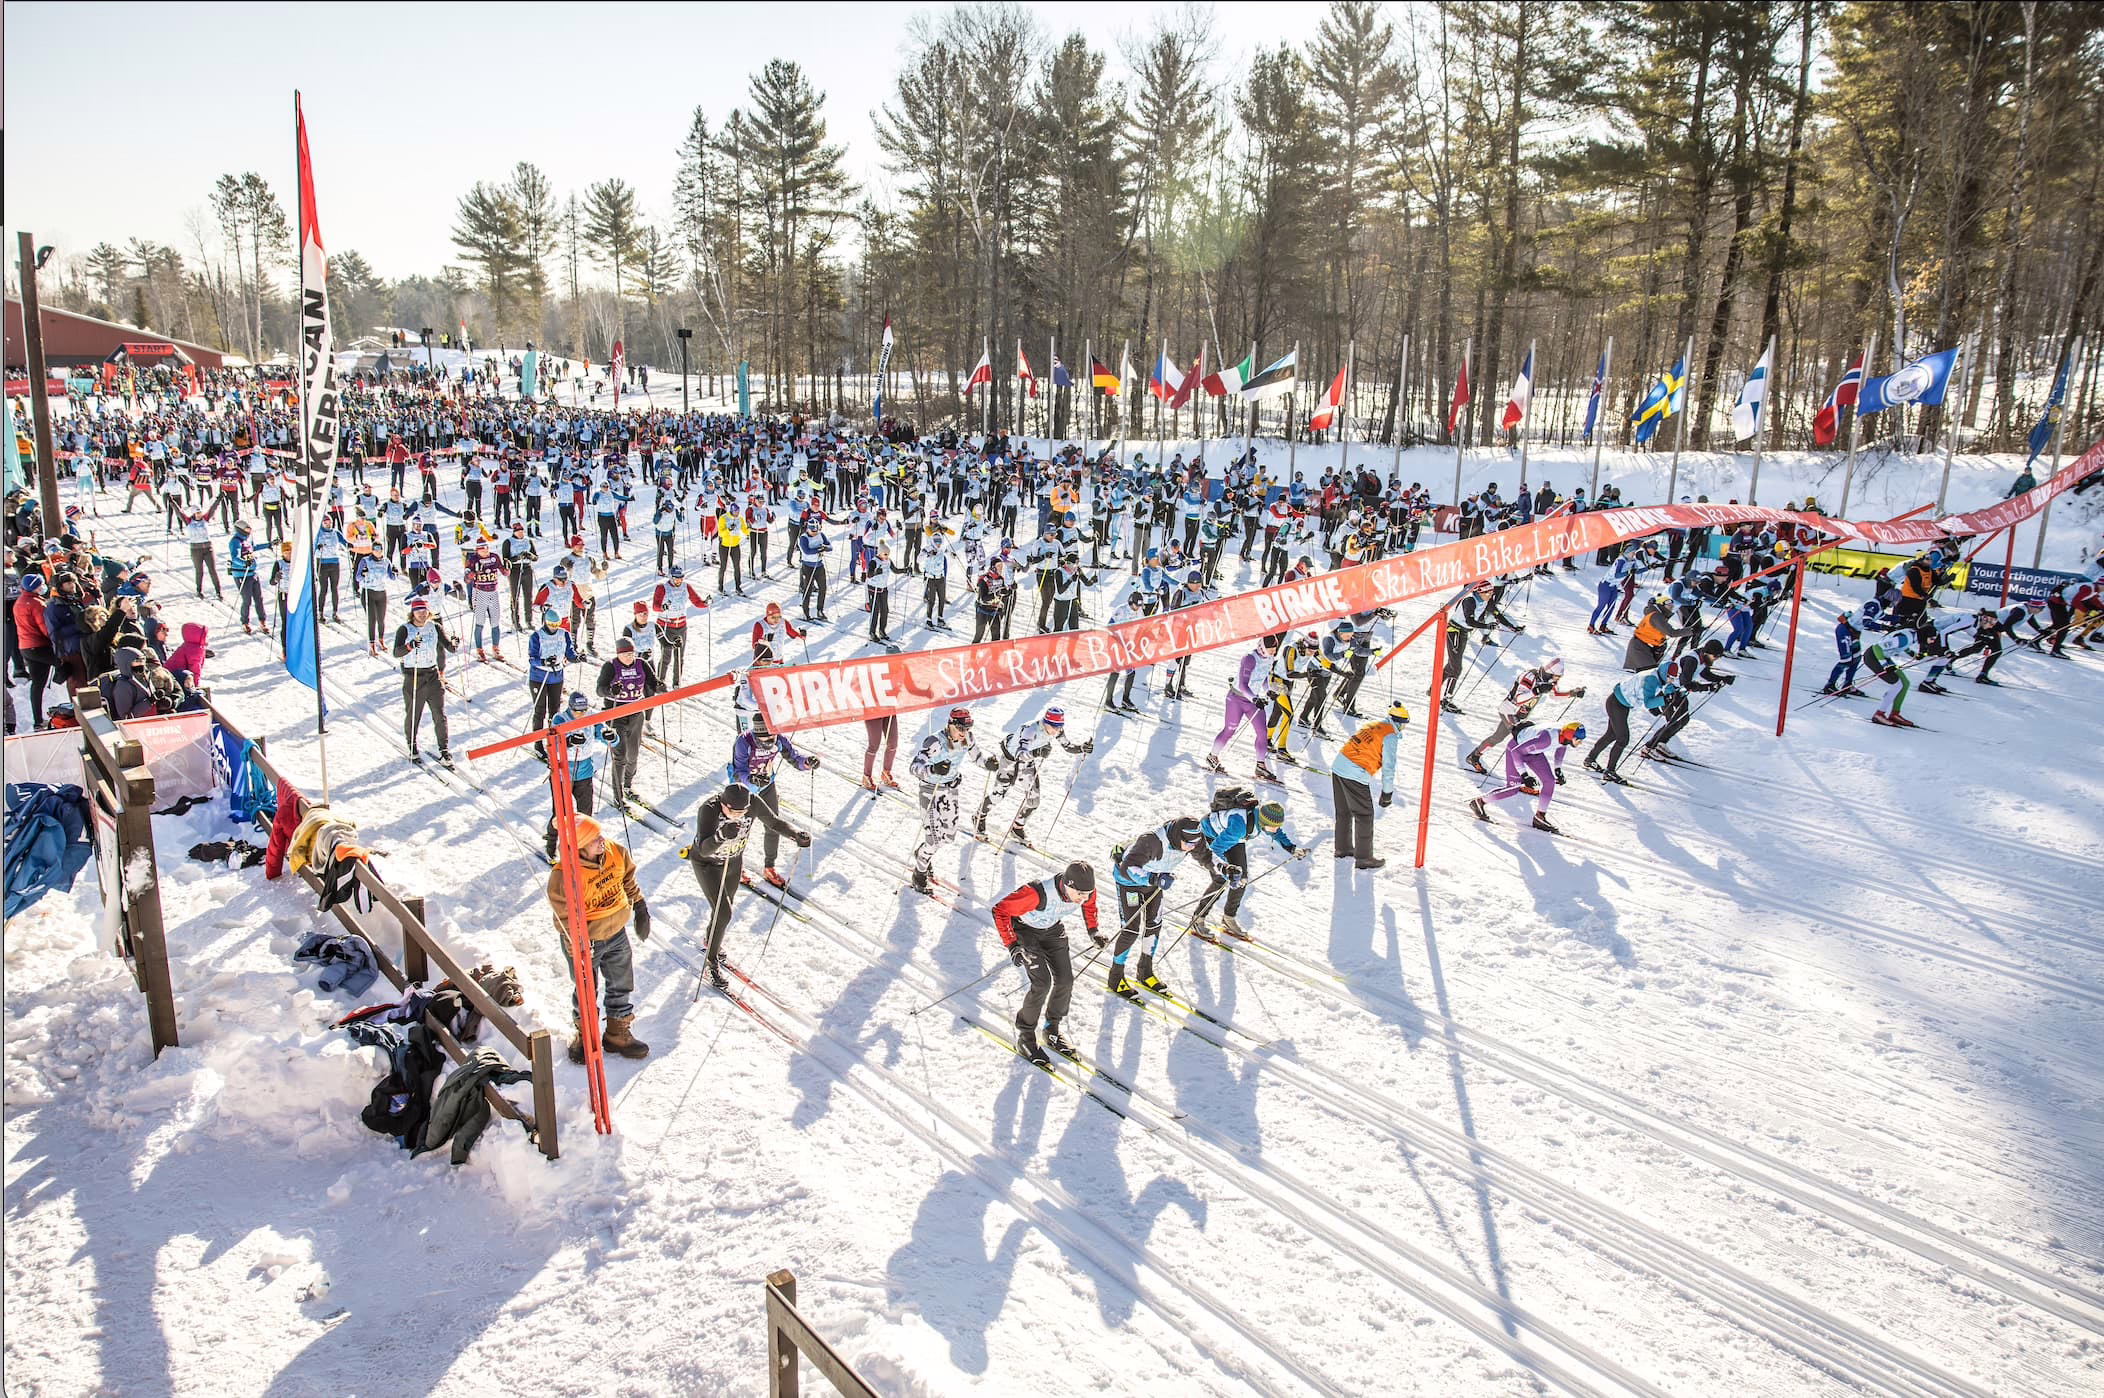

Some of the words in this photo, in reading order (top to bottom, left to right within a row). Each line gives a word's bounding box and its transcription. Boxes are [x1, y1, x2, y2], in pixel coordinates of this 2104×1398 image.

[134, 345, 167, 353] START
[1604, 508, 1682, 537] BIRKIE
[1371, 563, 1416, 602] Ski.
[1419, 557, 1471, 589] Run.
[1475, 534, 1531, 576] Bike.
[1534, 517, 1590, 560] Live!
[1970, 579, 2004, 594] Sports
[2007, 584, 2053, 597] Medici
[1973, 567, 1998, 579] Your
[2001, 570, 2065, 585] rthopedi
[759, 662, 899, 726] BIRKIE
[937, 656, 1003, 700] Ski.
[1009, 645, 1075, 687] Run.
[1086, 629, 1160, 673] Bike.
[1164, 609, 1237, 654] Live!
[1253, 576, 1352, 630] BIRKIE
[584, 882, 625, 909] VOLUNTE
